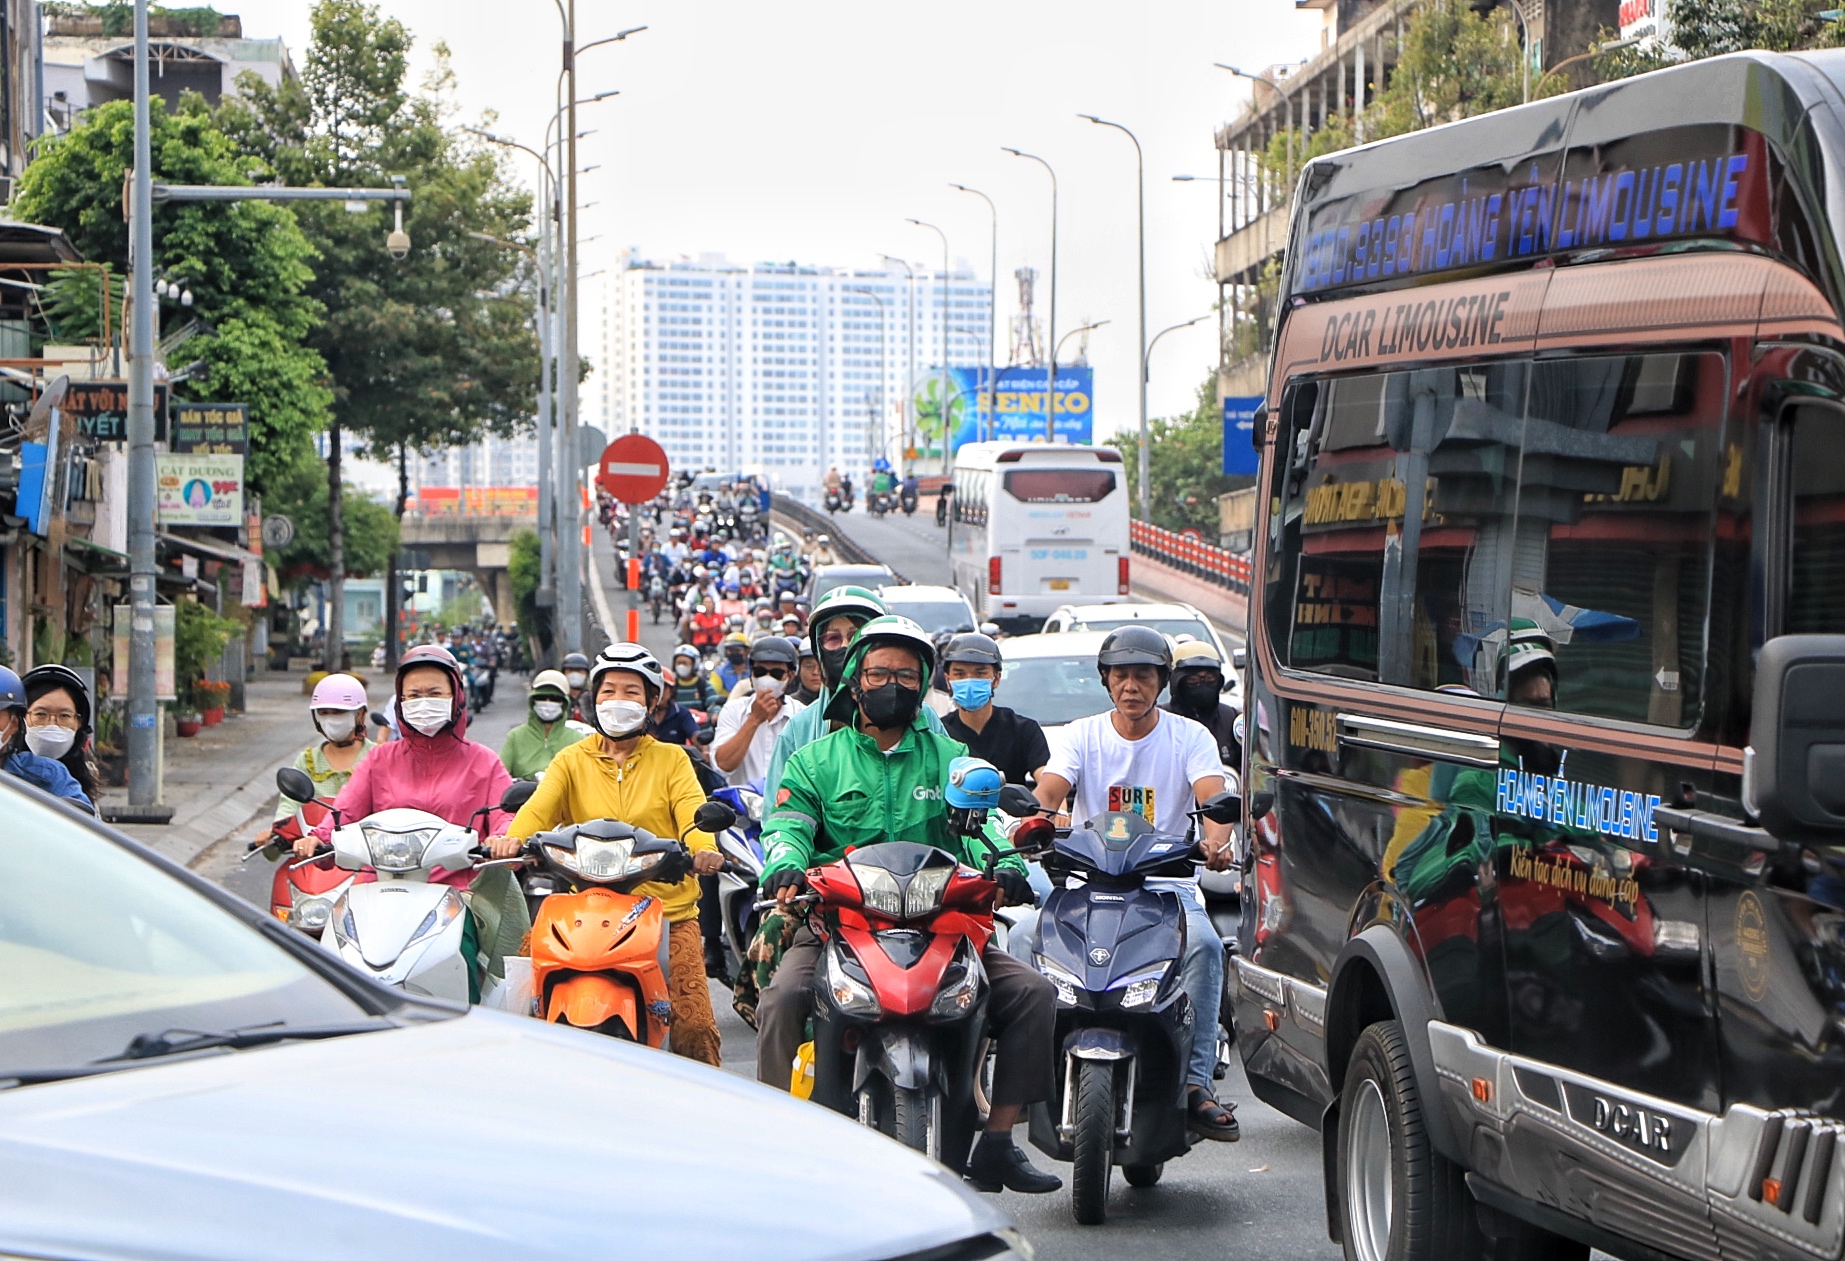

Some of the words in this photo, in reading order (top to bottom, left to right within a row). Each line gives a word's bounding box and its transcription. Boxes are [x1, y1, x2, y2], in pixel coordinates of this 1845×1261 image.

[1420, 178, 1502, 271] HOÀNG
[1558, 154, 1749, 249] LIMOUSINE
[1320, 308, 1377, 363] DCAR
[1377, 291, 1511, 355] LIMOUSINE
[977, 392, 1090, 414] SENKO
[1110, 788, 1153, 804] SURF
[1497, 755, 1545, 820] HOÀNG
[1546, 750, 1577, 827] YẾN
[1576, 782, 1661, 843] LIMOUSINE
[1594, 1096, 1670, 1151] DCAR
